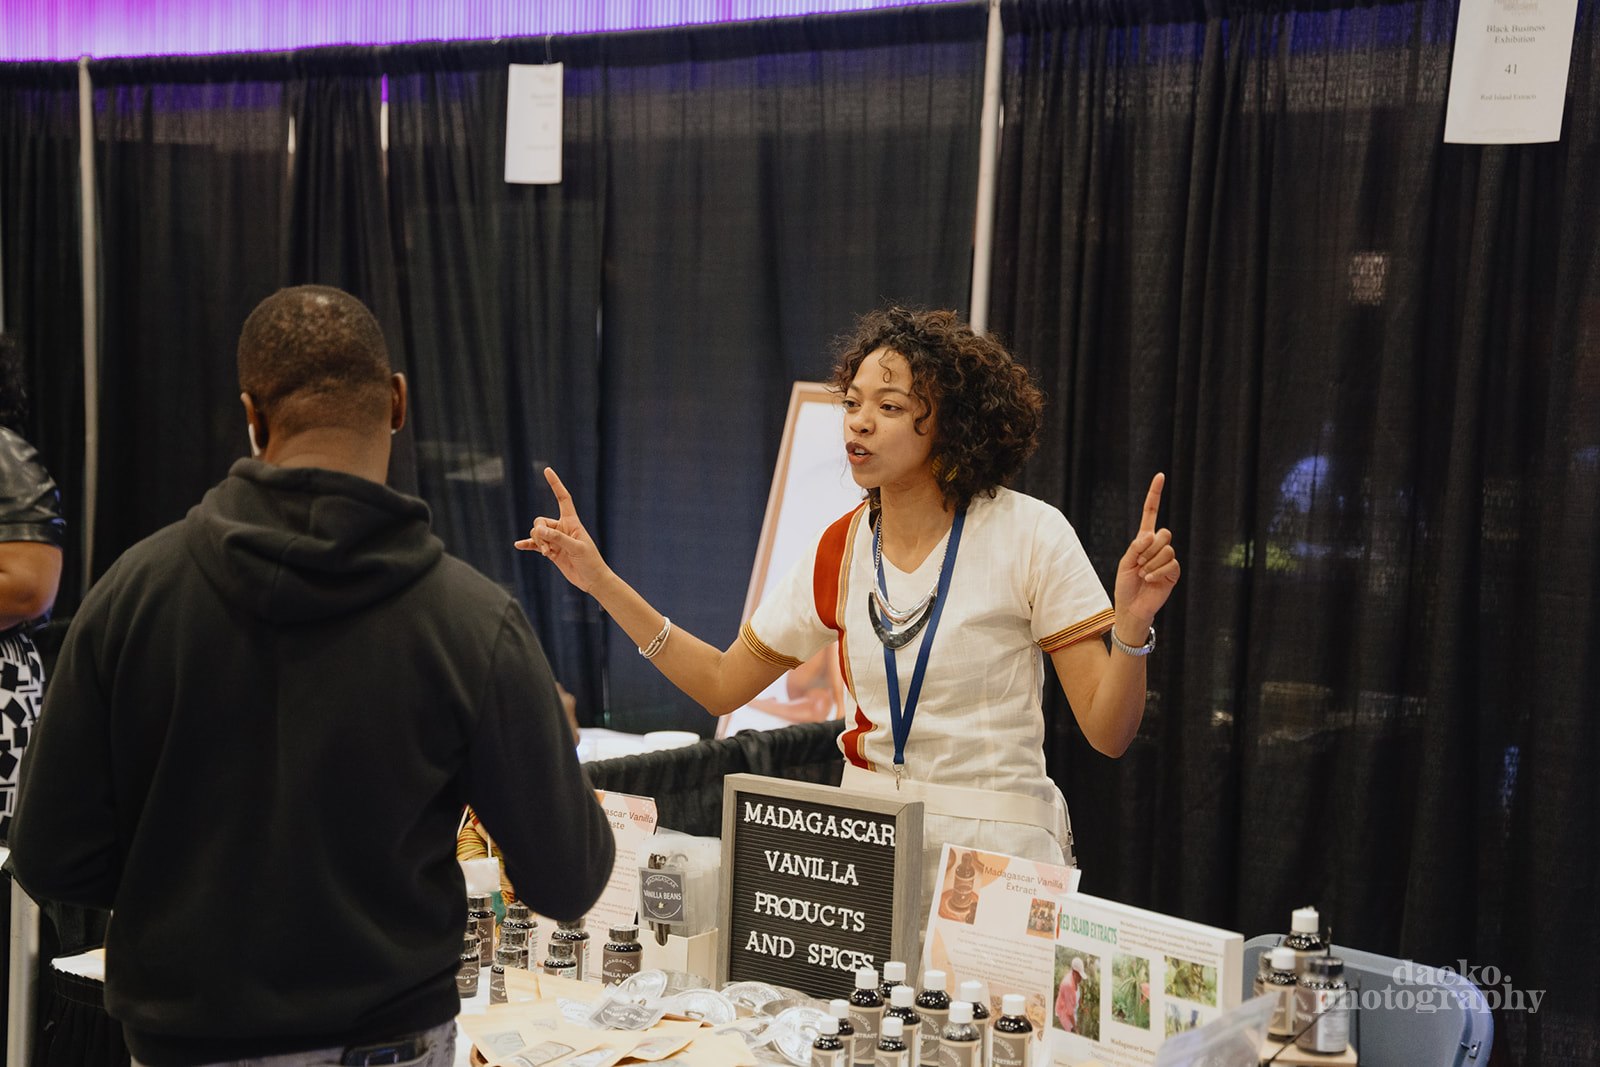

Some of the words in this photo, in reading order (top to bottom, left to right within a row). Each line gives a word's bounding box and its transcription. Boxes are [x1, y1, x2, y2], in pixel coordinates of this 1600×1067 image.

[1486, 24, 1509, 33] Black
[1511, 24, 1546, 33] Business
[1494, 36, 1536, 44] Exhibition
[1503, 63, 1518, 75] 41
[629, 811, 654, 824] Vanilla
[744, 802, 895, 846] MADAGASCAR
[764, 850, 860, 886] VANILLA
[984, 866, 1035, 884] Madagascar
[1037, 877, 1064, 890] Vanilla
[643, 889, 663, 900] VANILLA
[663, 892, 682, 901] BEANS
[1006, 882, 1037, 895] Extract
[754, 891, 866, 932] PRODUCTS
[1090, 921, 1118, 945] EXTRACTS
[745, 931, 796, 959] AND
[807, 943, 875, 974] SPICES
